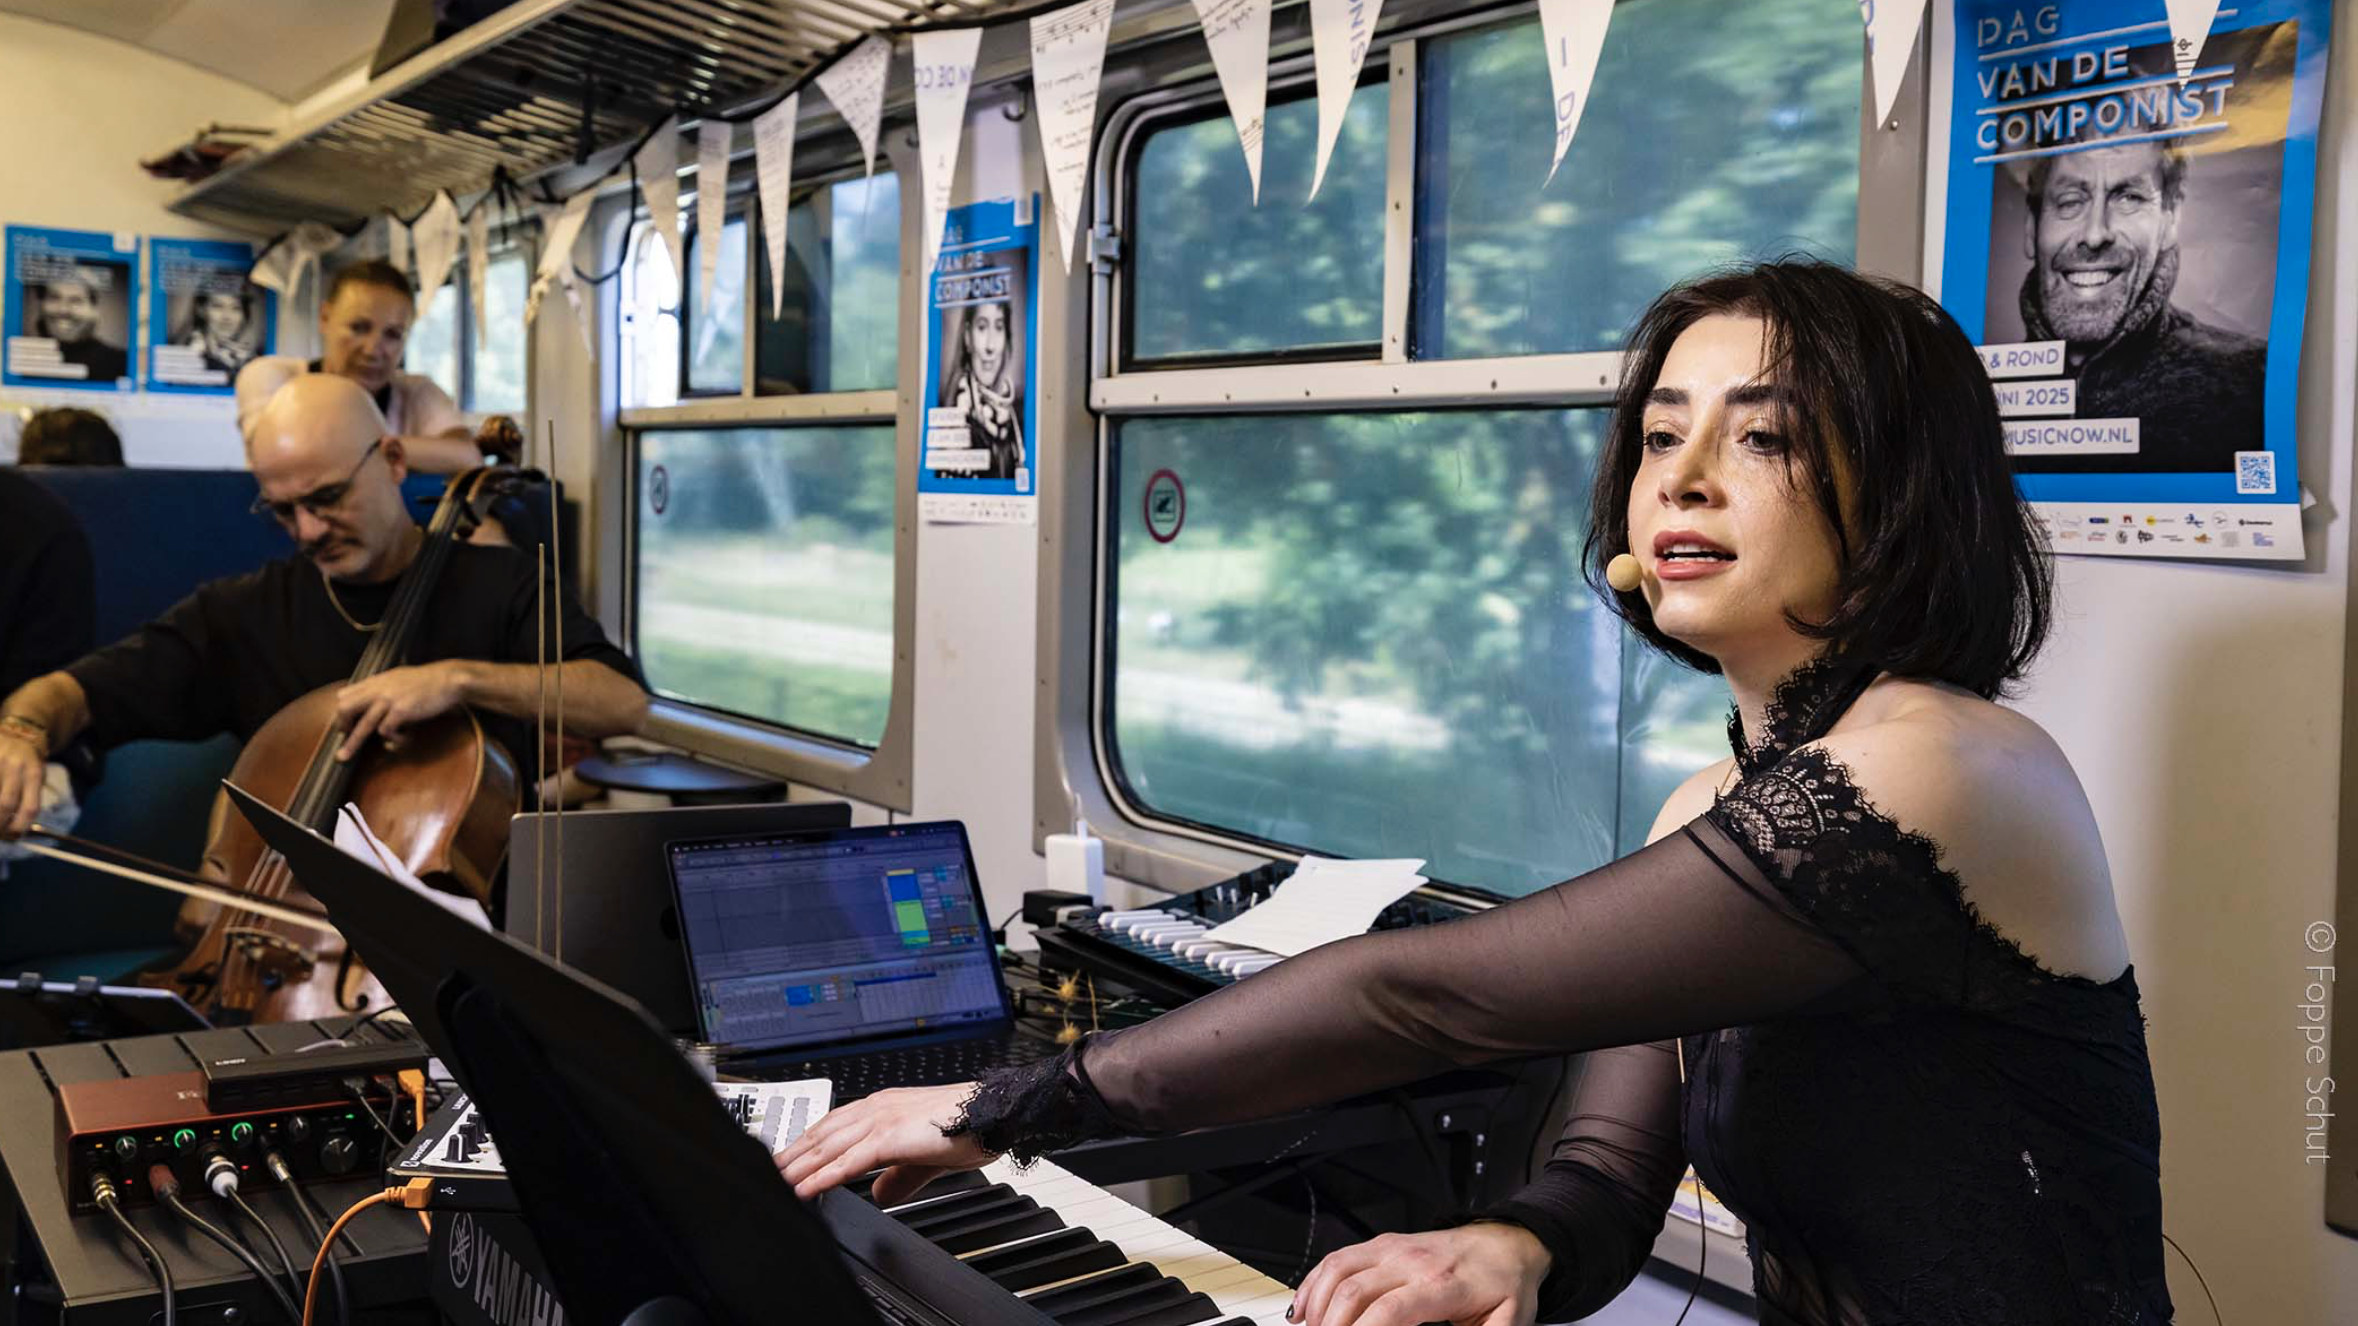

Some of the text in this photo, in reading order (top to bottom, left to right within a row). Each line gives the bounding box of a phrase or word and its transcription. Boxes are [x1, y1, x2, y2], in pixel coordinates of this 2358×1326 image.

[1977, 6, 2060, 48] DAG
[1977, 44, 2130, 98] VAN DE
[1976, 79, 2235, 149] COMPONIST
[935, 274, 1011, 302] COMPONIST
[1990, 353, 2001, 368] &
[2006, 348, 2060, 367] ROND
[2025, 387, 2070, 406] 2025
